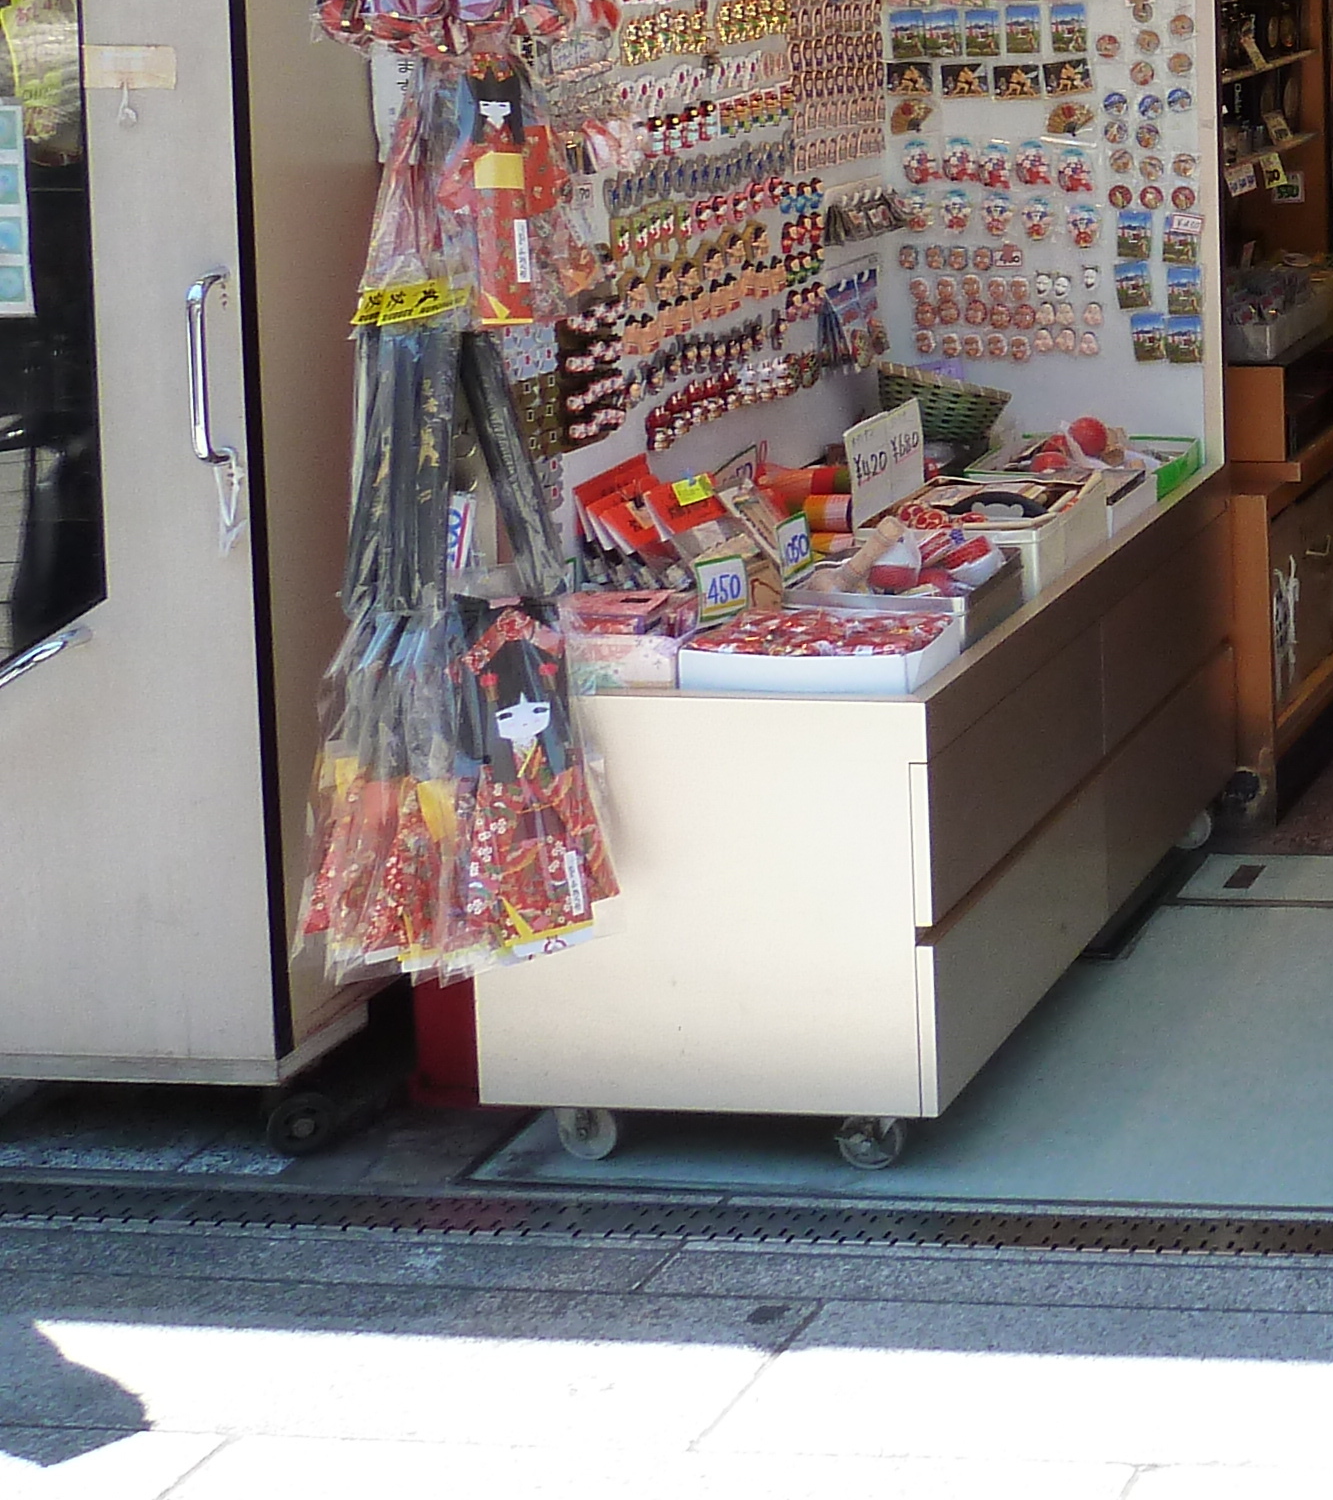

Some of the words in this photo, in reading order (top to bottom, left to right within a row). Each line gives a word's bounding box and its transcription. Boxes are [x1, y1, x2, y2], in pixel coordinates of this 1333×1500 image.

[889, 430, 921, 466] ¥680
[854, 451, 888, 486] ¥420
[706, 573, 742, 605] 450
